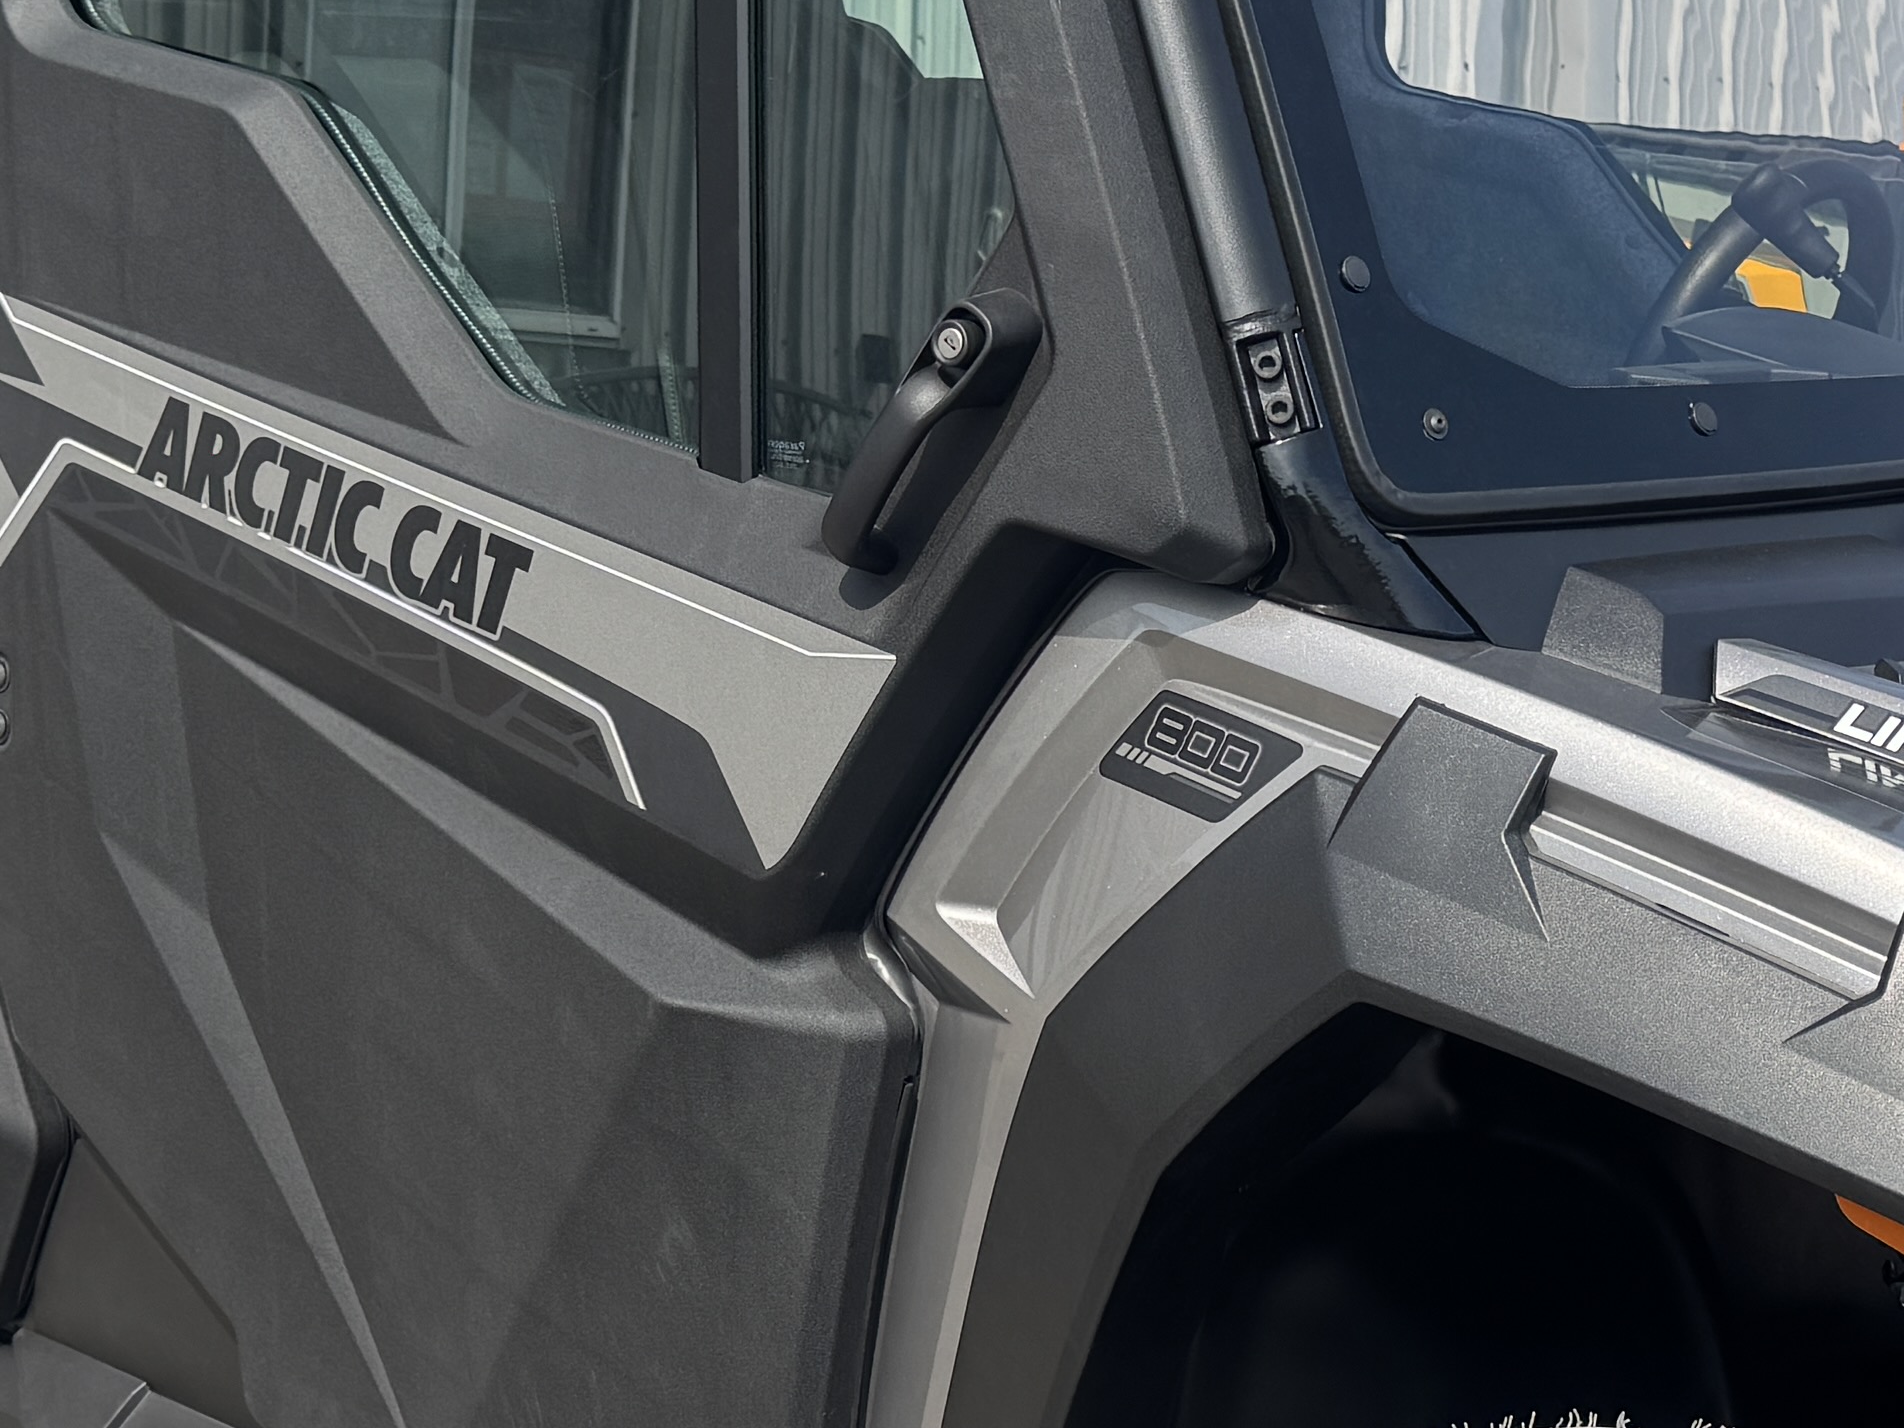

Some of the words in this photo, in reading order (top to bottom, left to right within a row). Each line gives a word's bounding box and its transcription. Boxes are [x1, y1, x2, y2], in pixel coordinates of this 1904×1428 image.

[137, 395, 386, 574] ARCTIC
[389, 504, 535, 636] CAT
[1144, 704, 1263, 787] 800
